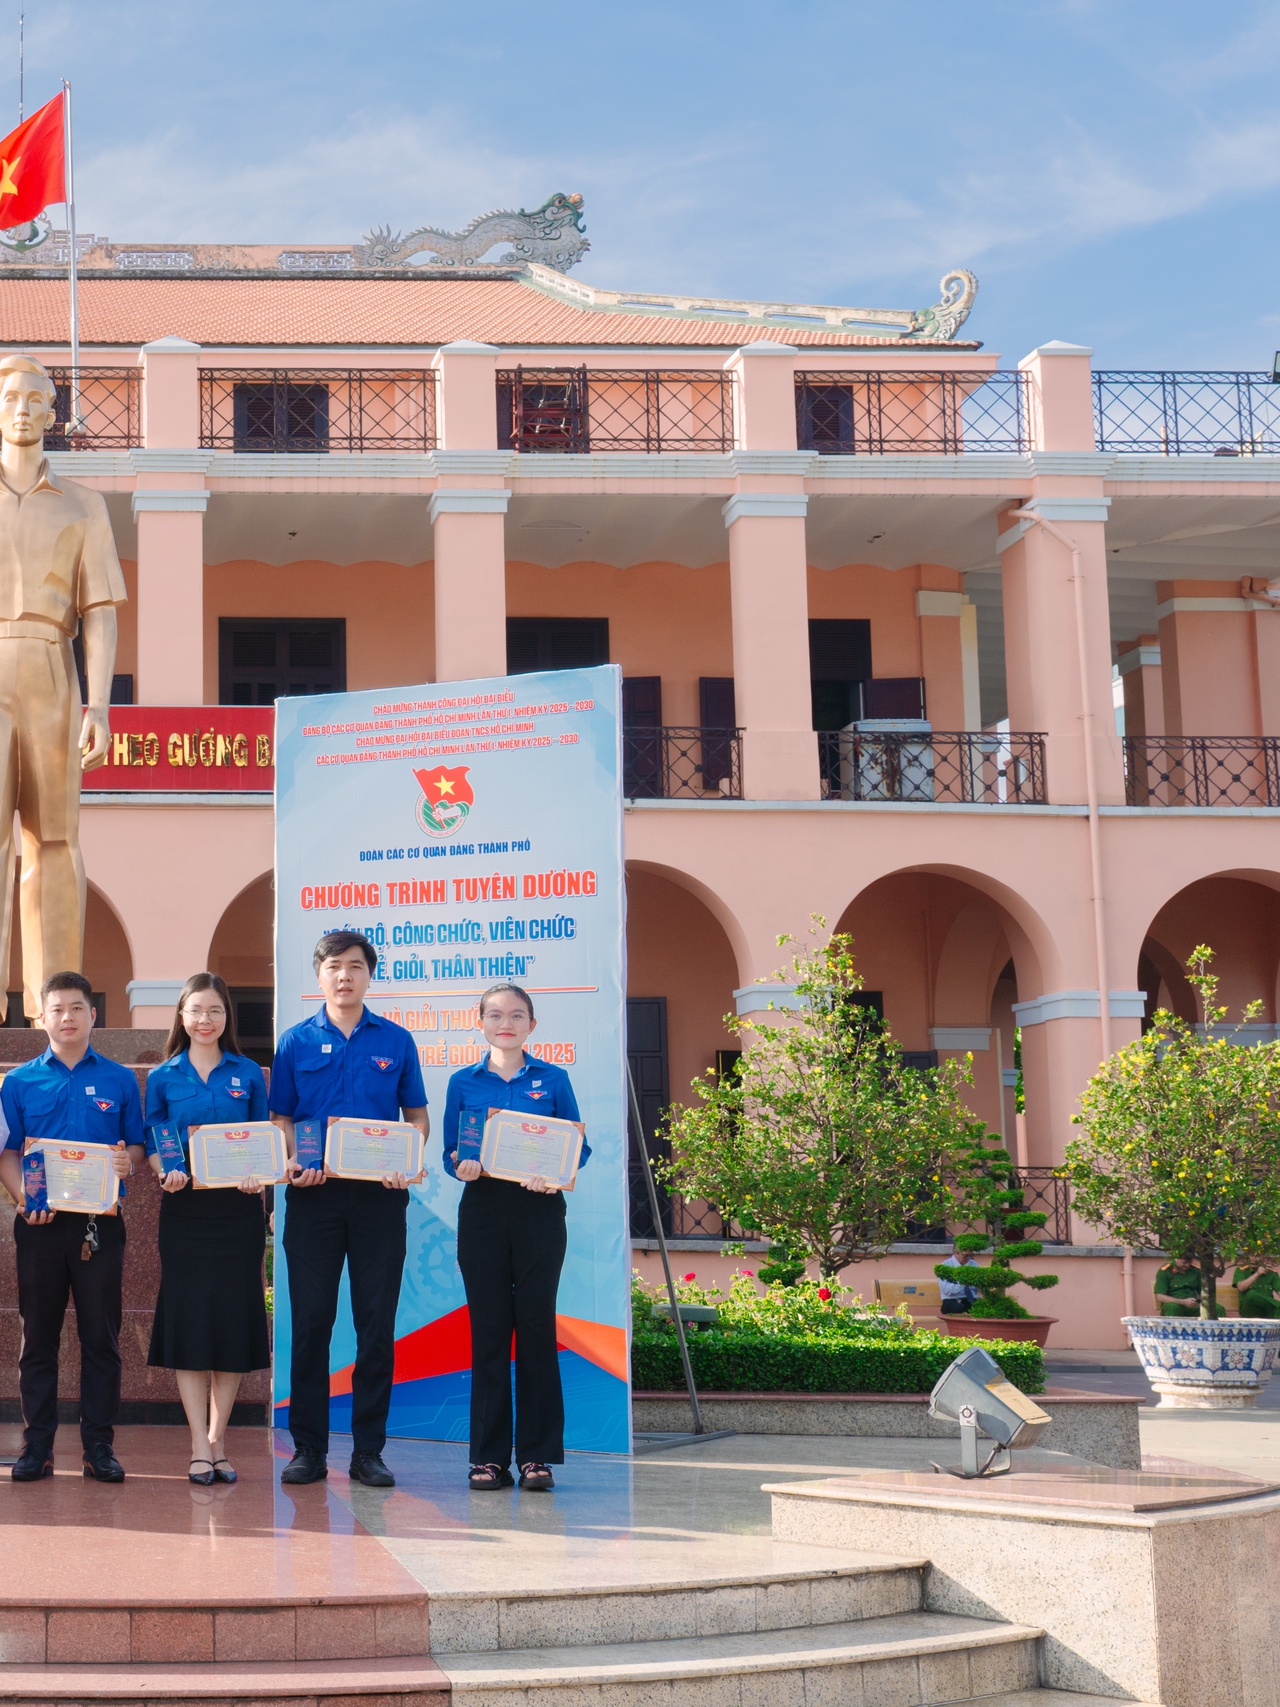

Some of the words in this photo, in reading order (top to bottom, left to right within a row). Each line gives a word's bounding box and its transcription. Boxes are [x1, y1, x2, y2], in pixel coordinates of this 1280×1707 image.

[356, 721, 374, 732] QUAN
[458, 711, 475, 721] MINH
[549, 702, 568, 712] 2025
[575, 700, 594, 710] 2030
[471, 726, 489, 736] TNCS
[516, 722, 534, 732] MINH
[168, 727, 249, 767] GƯƠNG
[341, 753, 358, 764] QUAN
[442, 744, 460, 754] MINH
[533, 736, 551, 746] 2025
[560, 733, 578, 743] 2030
[359, 847, 383, 861] ĐOÀN
[387, 846, 404, 860] CÁC
[407, 846, 420, 859] CƠ
[422, 846, 447, 859] QUAN
[449, 842, 475, 856] ĐẢNG
[478, 840, 508, 854] THÀNH
[512, 837, 531, 852] PHỐ
[300, 881, 380, 909] CHƯƠNG
[386, 877, 446, 905] TRÌNH
[453, 872, 515, 902] TUYÊN
[523, 869, 597, 898] DƯƠNG
[392, 920, 434, 945] CÔNG
[437, 918, 485, 945] CHỨC,
[489, 916, 525, 942] VIÊN
[529, 914, 575, 940] CHỨC
[393, 953, 429, 981] GIỎI,
[431, 953, 478, 980] THÂN
[405, 1003, 437, 1031] GIẢI
[533, 1043, 574, 1063] 2025
